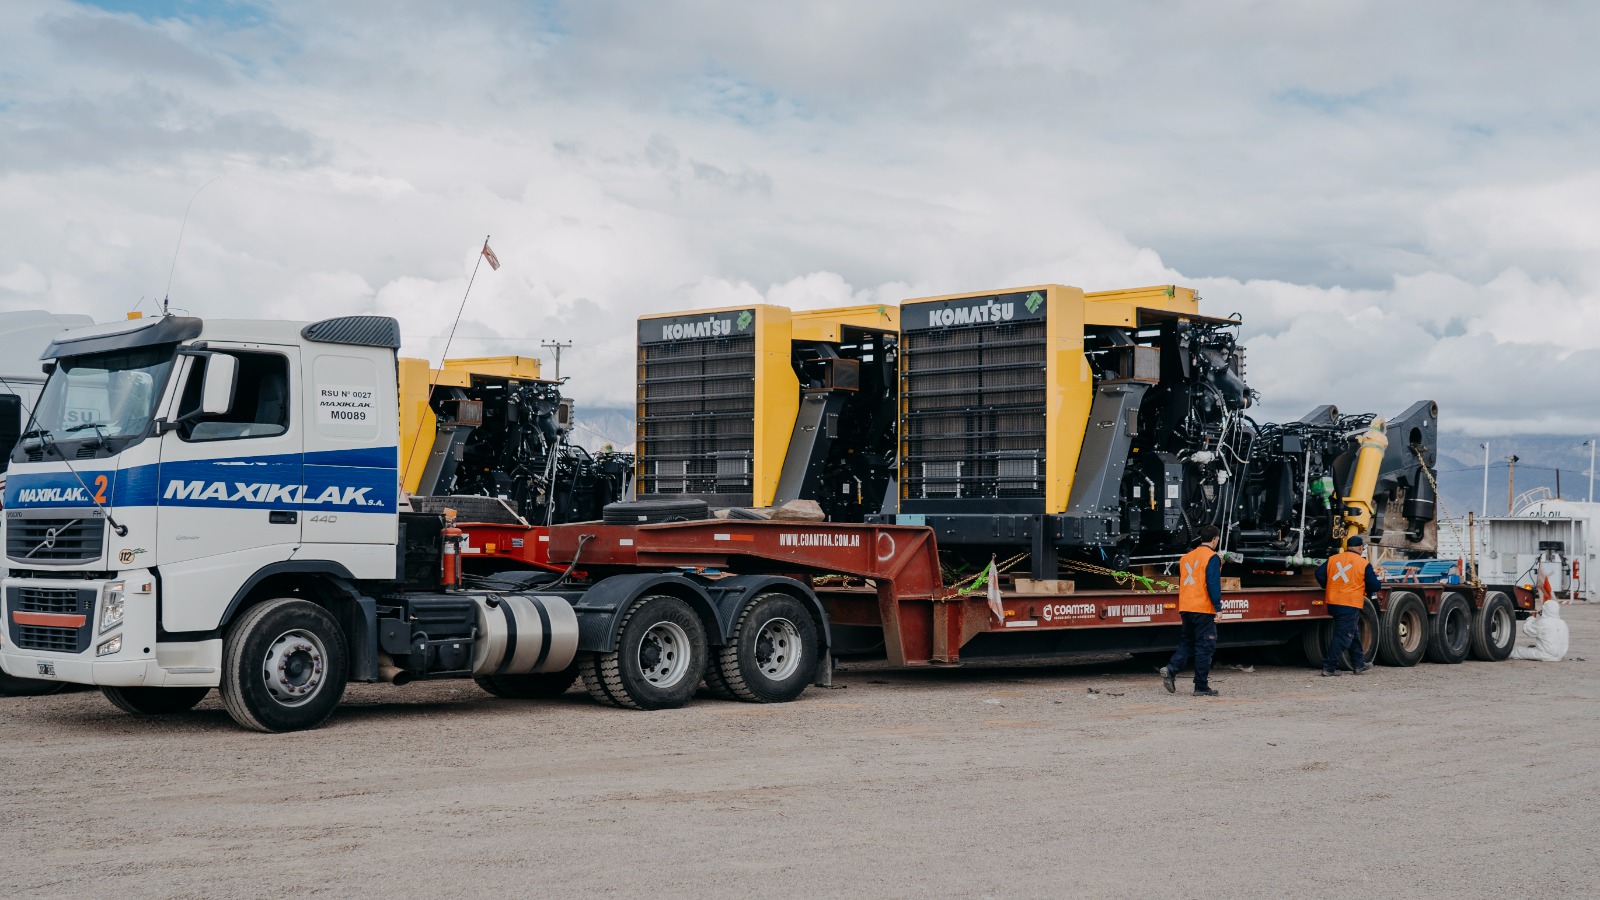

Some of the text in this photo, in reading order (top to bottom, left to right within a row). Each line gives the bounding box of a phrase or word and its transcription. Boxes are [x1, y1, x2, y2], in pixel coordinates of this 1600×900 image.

[929, 300, 1014, 327] KOMATSU
[663, 317, 731, 340] KOMATSU
[352, 391, 372, 399] 0027
[64, 410, 93, 423] SU
[331, 410, 366, 421] M0089
[18, 487, 86, 503] MAXIKLAK
[93, 474, 108, 505] 2
[163, 479, 385, 507] MAXIKLAK S.A.
[309, 515, 338, 524] 440
[780, 533, 860, 547] WWW.COAMTRA.COM.AR
[1053, 603, 1096, 616] COAMTRA
[1220, 599, 1249, 610] OAMTRA
